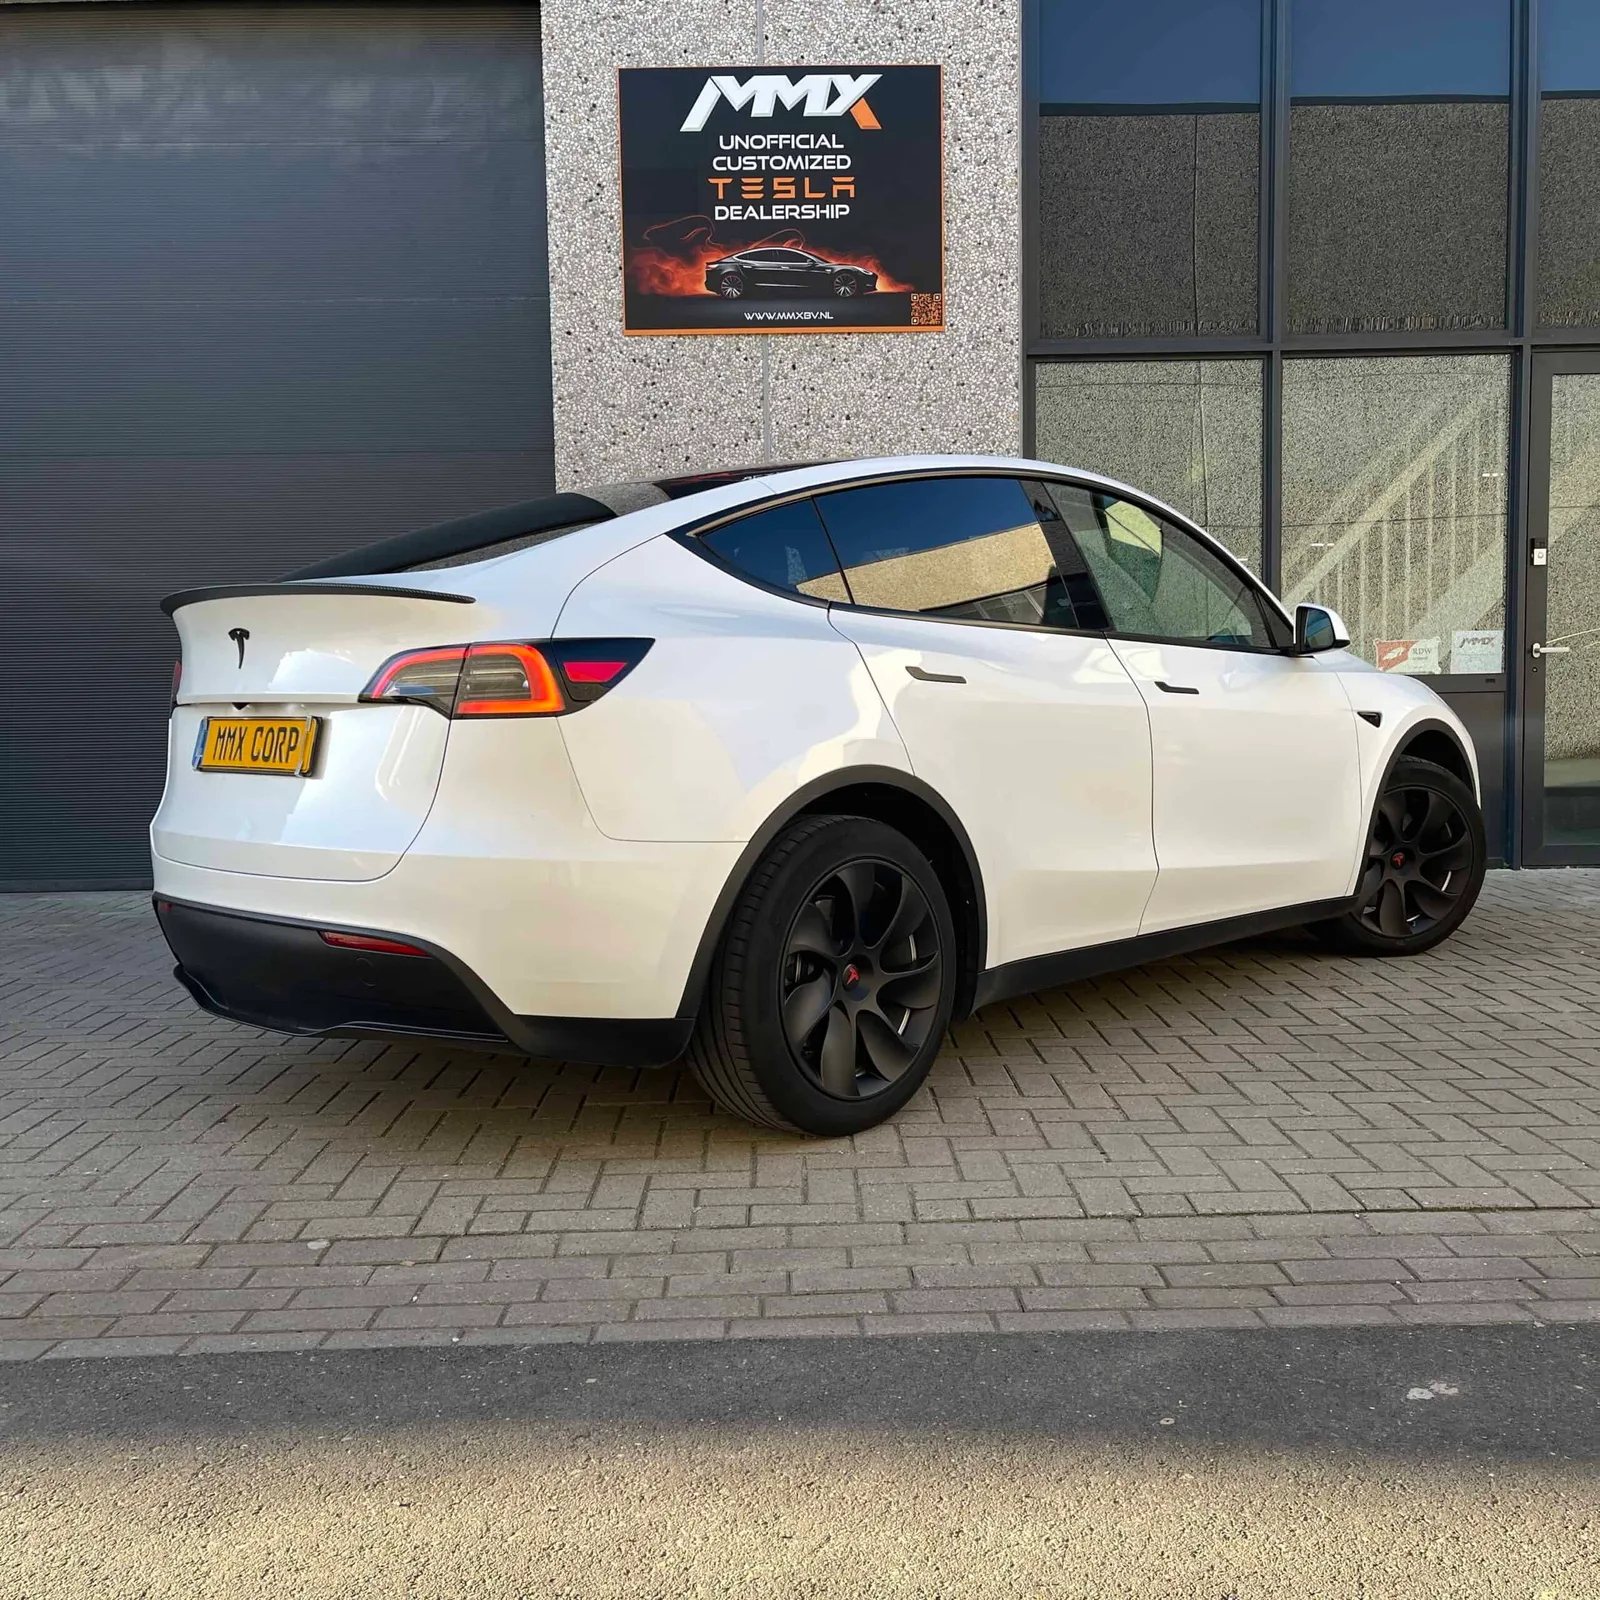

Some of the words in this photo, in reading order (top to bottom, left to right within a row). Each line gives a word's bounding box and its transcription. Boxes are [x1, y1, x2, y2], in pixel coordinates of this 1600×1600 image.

[680, 74, 883, 132] MMX
[719, 134, 844, 150] UNOFFICIAL
[712, 155, 851, 171] CUSTOMIZED
[707, 177, 855, 200] TESLA
[714, 204, 850, 220] DEALERSHIP
[744, 311, 834, 320] WWW.MMXBV.NL
[213, 726, 248, 761] MMX
[251, 726, 300, 763] CORP
